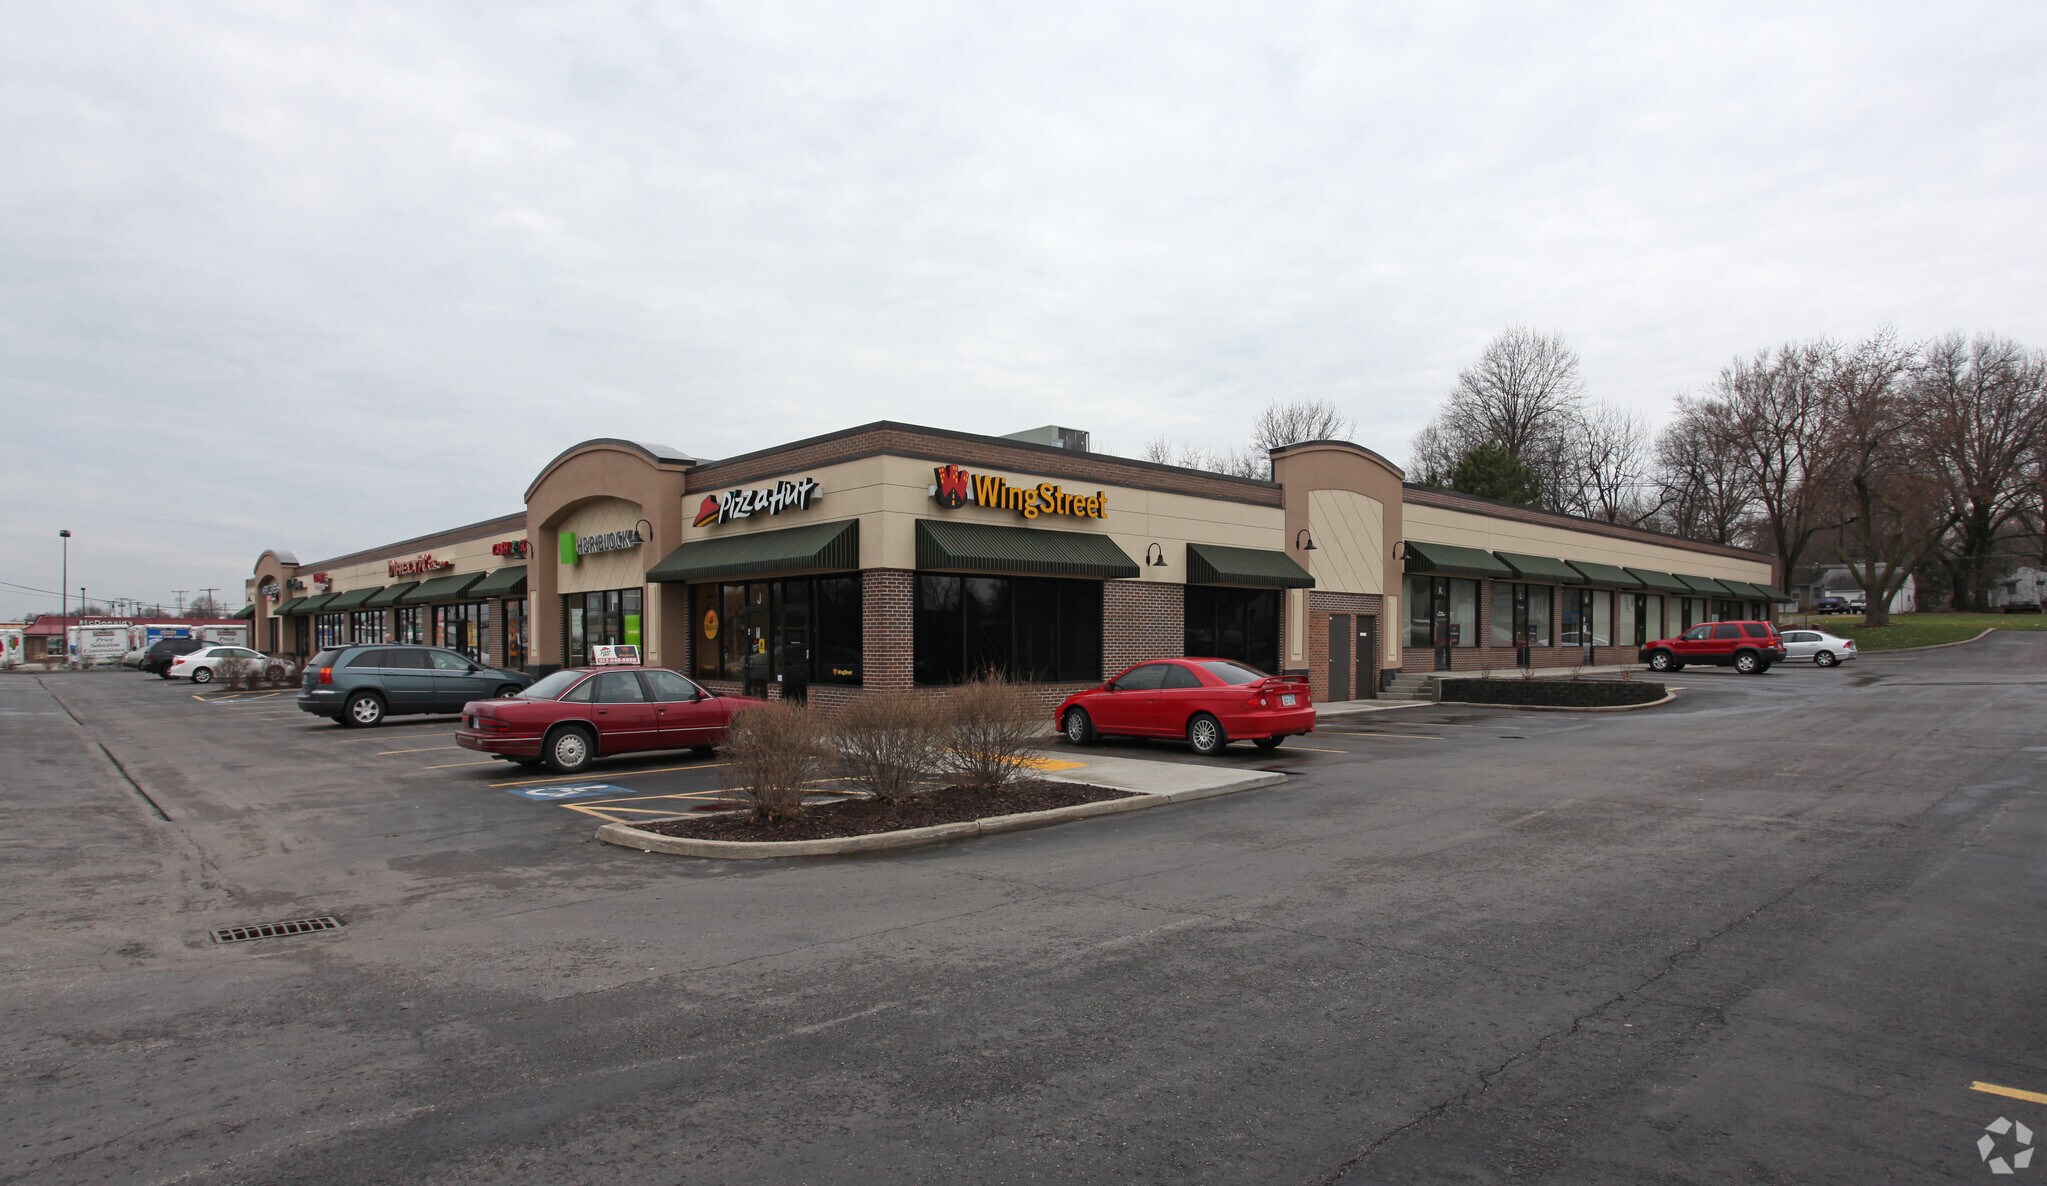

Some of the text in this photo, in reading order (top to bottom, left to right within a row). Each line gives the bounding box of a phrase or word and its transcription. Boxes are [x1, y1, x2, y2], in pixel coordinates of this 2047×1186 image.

[718, 477, 816, 525] Pizza Hut
[972, 473, 1108, 519] WingStreet
[596, 530, 632, 552] BLOCK
[756, 592, 762, 605] J
